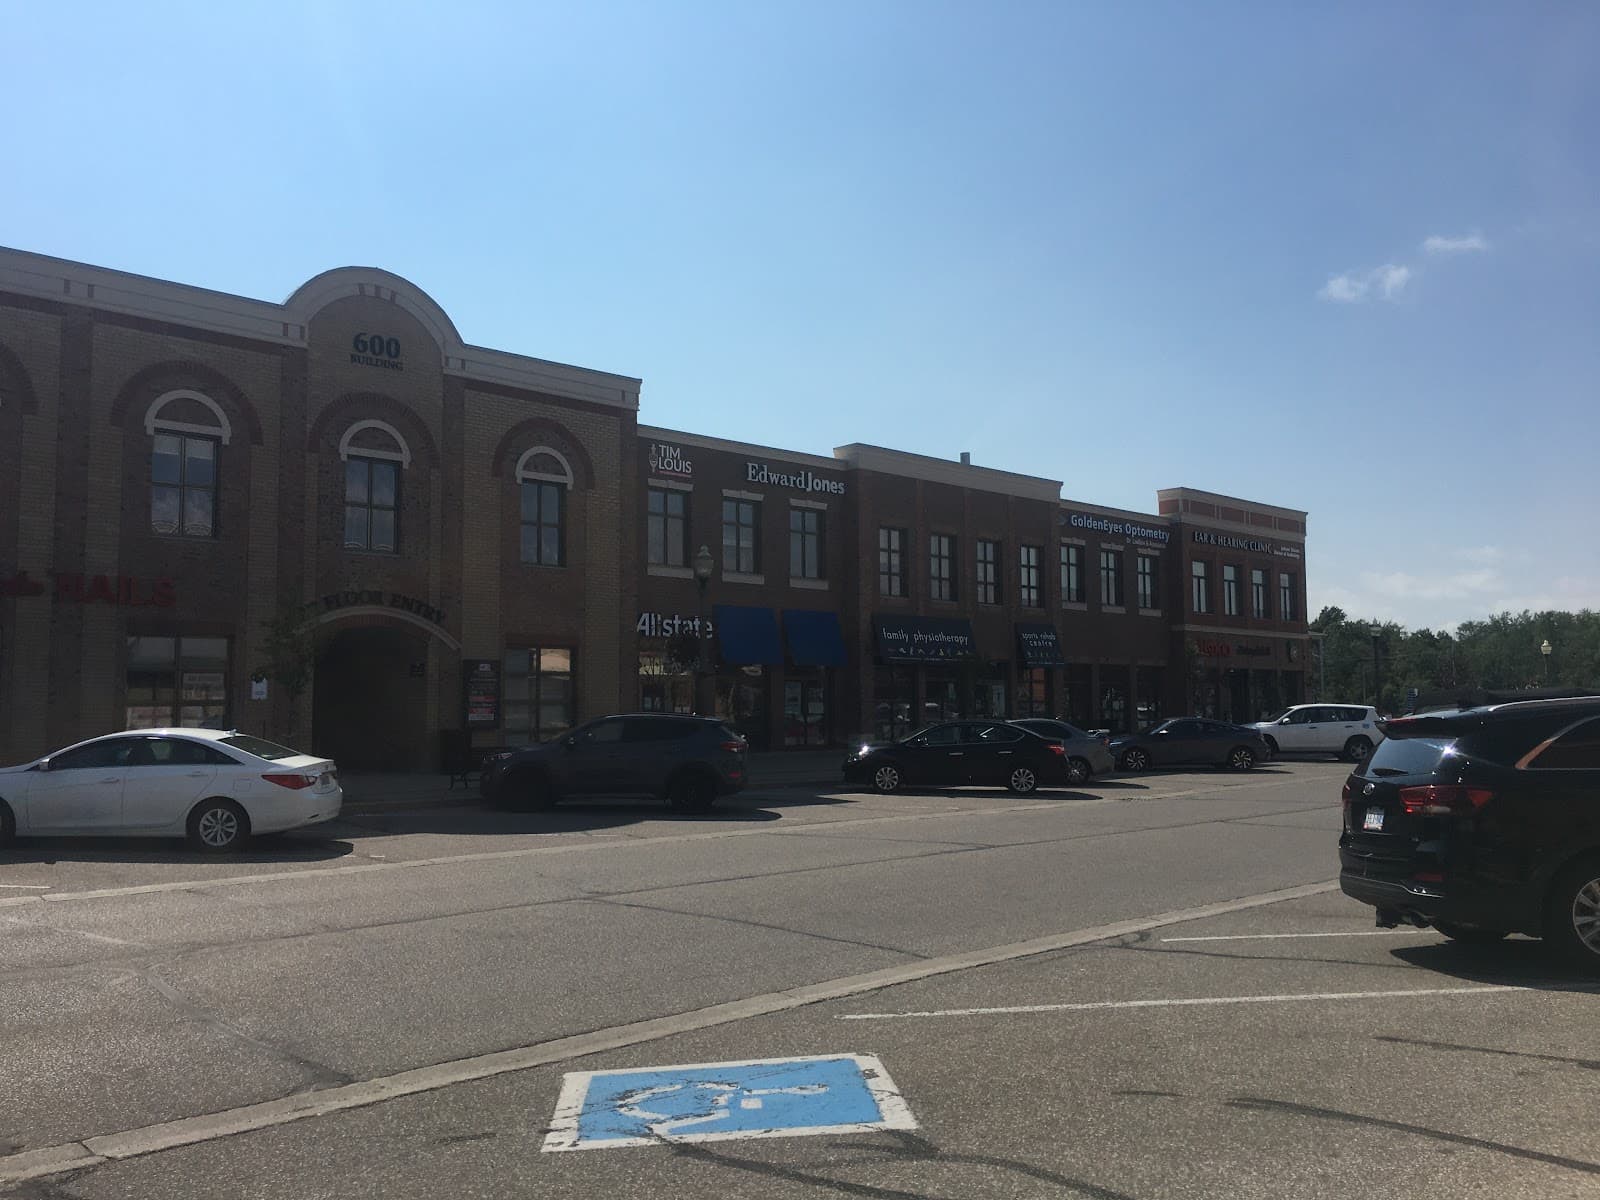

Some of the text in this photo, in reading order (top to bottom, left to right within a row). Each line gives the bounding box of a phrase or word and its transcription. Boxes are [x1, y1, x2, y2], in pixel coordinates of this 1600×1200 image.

[353, 332, 401, 358] 600
[350, 354, 403, 371] BUILDING
[659, 444, 681, 460] TIM
[658, 458, 693, 474] LOUIS
[1071, 514, 1123, 534] GoldenEyes
[1125, 523, 1170, 543] Optometry
[1194, 531, 1209, 543] EAR
[1218, 535, 1248, 550] HEARING
[1250, 541, 1272, 554] CLINIC
[57, 575, 177, 607] NAILS
[882, 627, 969, 646] family physiotherapy
